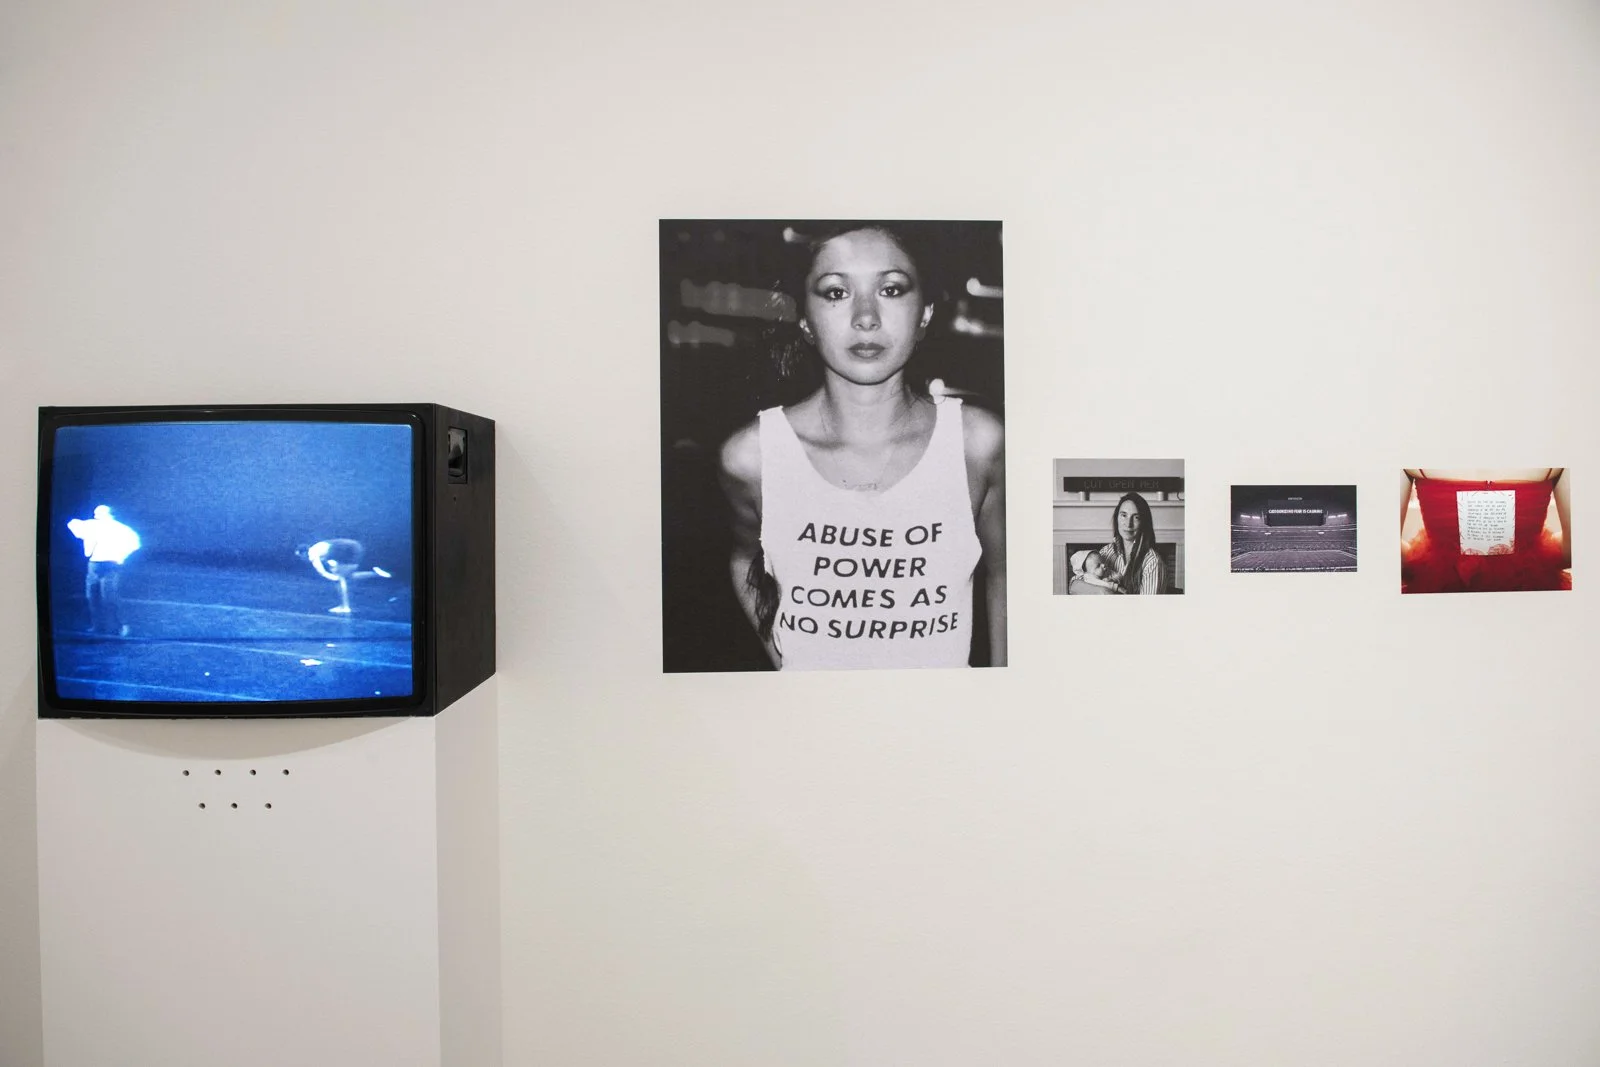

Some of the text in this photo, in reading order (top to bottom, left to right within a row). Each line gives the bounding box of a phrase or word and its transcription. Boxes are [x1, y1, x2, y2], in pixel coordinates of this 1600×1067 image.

[797, 522, 943, 547] ABUSE OF
[813, 556, 926, 578] POWER
[791, 585, 947, 609] COMES AS
[780, 612, 958, 639] NO SURPRISE
